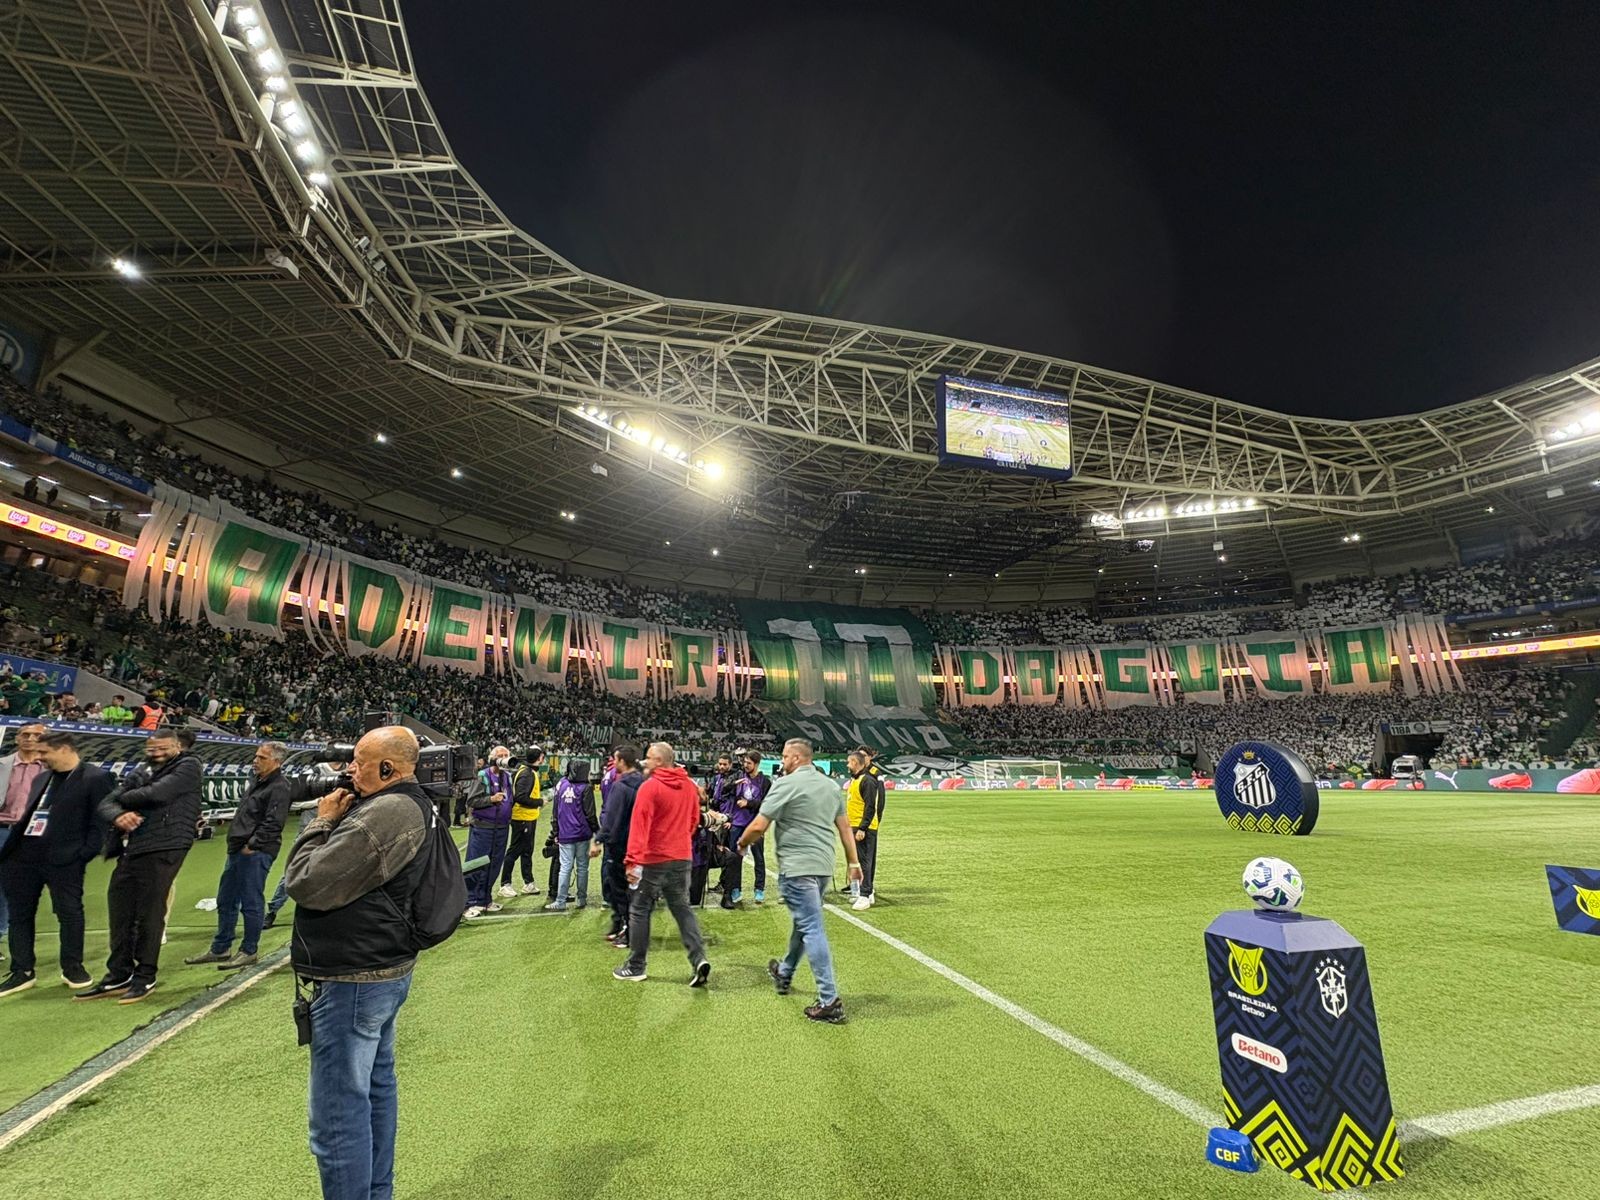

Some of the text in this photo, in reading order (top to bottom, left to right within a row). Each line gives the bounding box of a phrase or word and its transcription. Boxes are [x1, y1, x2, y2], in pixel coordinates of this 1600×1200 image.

[68, 451, 97, 469] Allianz
[207, 521, 713, 687] ADEMIR
[767, 618, 929, 720] 10
[792, 718, 953, 750] DIVINO
[1391, 726, 1410, 735] 118A
[970, 780, 1008, 789] ULTRA
[1228, 991, 1278, 1013] BRASILEIRÃO
[1242, 1003, 1265, 1018] Betano
[1238, 1039, 1281, 1066] Betano
[1215, 1147, 1240, 1163] CBF
